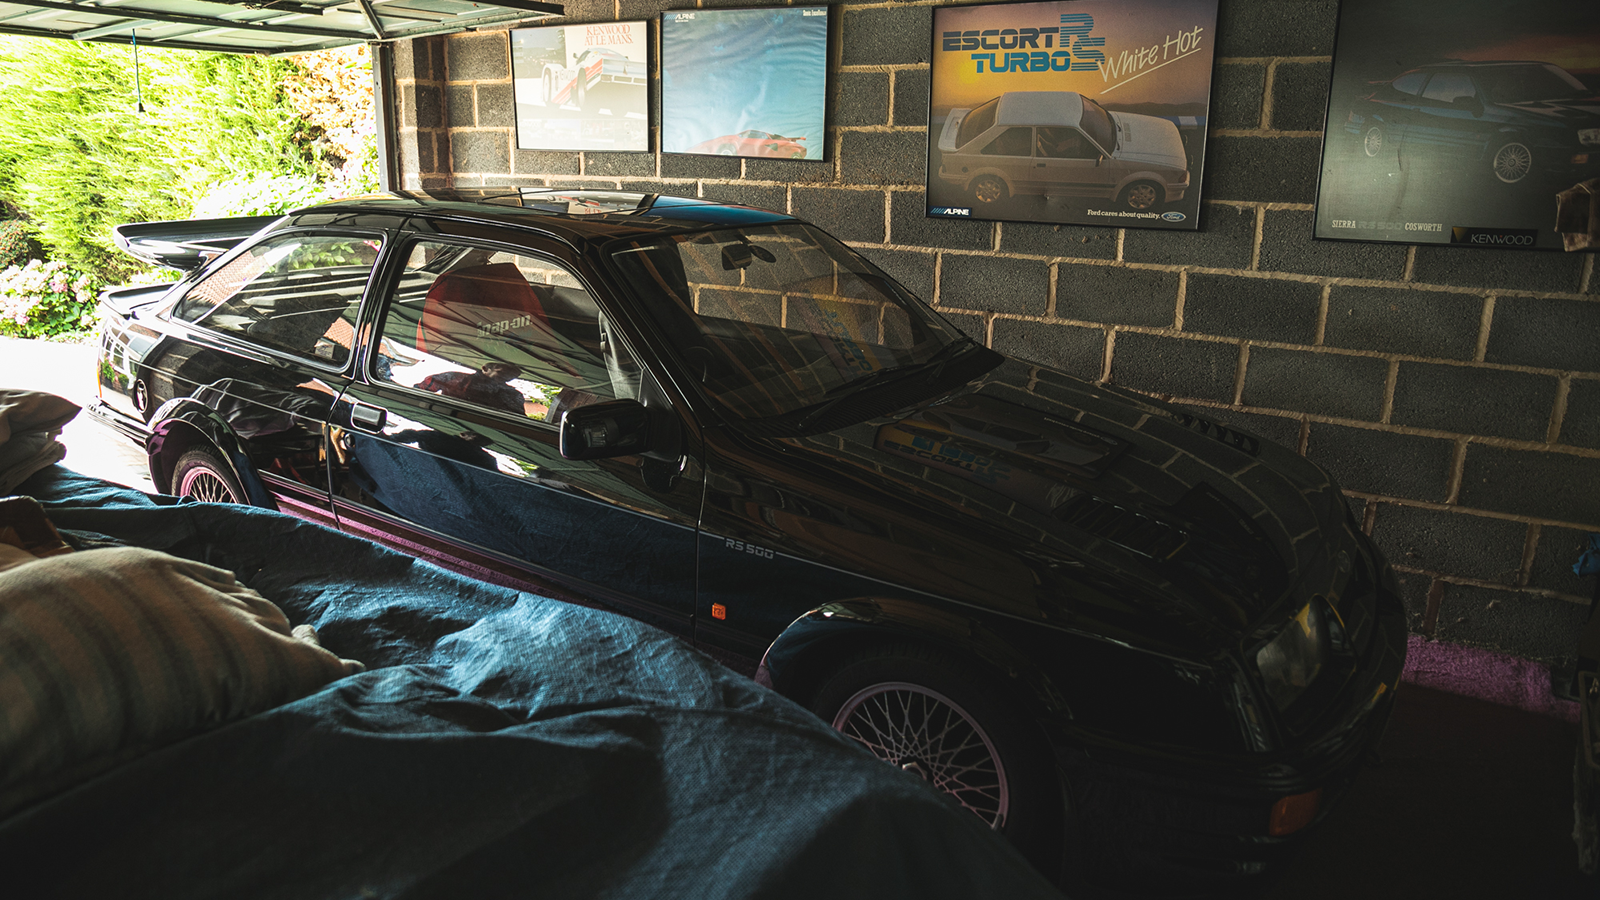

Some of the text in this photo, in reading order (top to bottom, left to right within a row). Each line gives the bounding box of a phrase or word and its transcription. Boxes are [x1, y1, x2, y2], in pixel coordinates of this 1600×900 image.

[586, 24, 631, 36] KENWOOD
[584, 36, 595, 46] AT
[595, 35, 607, 46] LE
[942, 27, 1060, 52] ESCORT
[1098, 25, 1204, 82] White Hot
[970, 50, 1071, 74] TURBO
[943, 208, 970, 216] ALPINE
[1136, 212, 1161, 220] quality.
[1331, 219, 1356, 229] SIERRA
[1405, 222, 1443, 232] COSWORTH
[1470, 233, 1534, 246] KENWOOD
